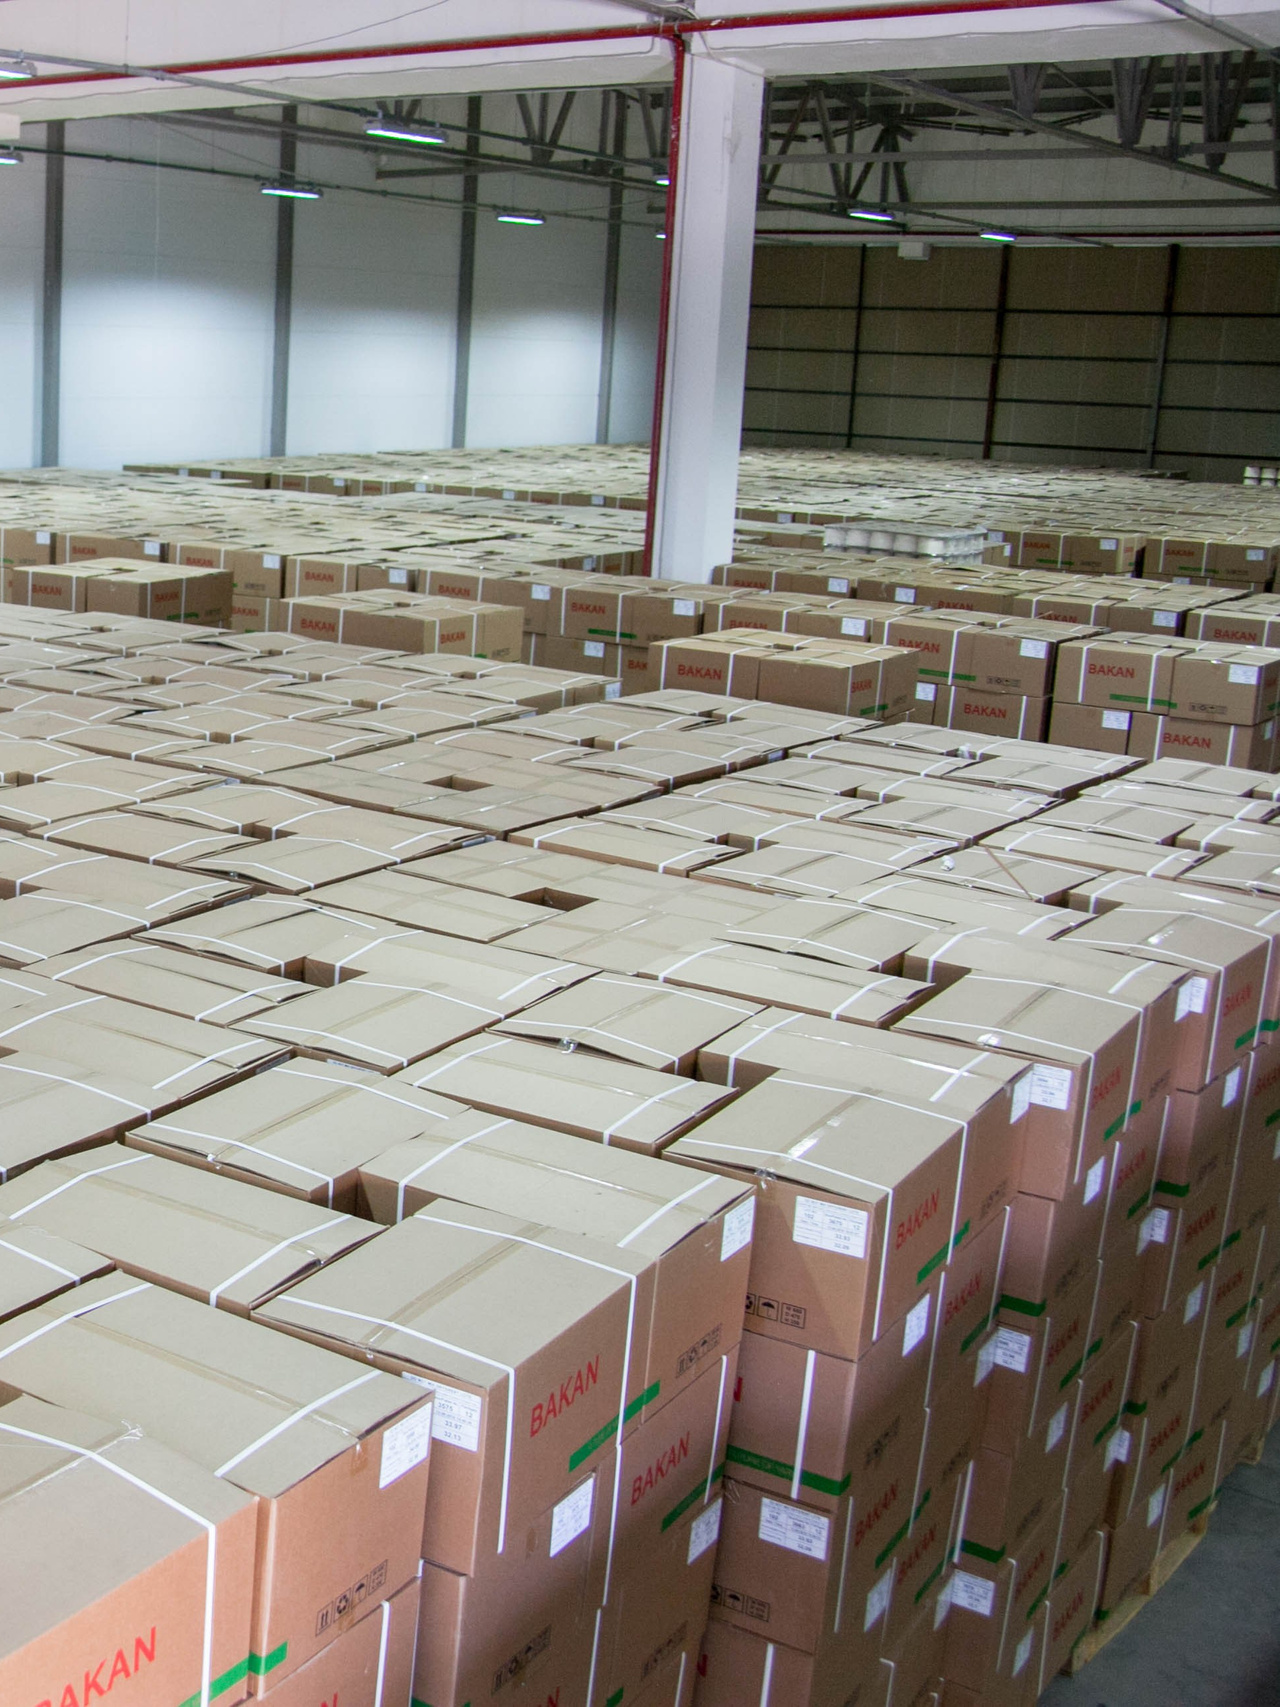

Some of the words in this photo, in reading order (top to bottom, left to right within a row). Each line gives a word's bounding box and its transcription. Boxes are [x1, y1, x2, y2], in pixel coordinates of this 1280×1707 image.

[186, 557, 213, 567] BAKAN
[305, 572, 333, 582] BAKAN
[32, 584, 61, 595] BAKAN
[439, 585, 470, 597] BAKAN
[154, 591, 179, 603] BAKAN
[231, 607, 258, 616] BAKAN
[571, 603, 605, 614] BAKAN
[937, 601, 972, 610] BAKAN
[301, 619, 335, 632] BAKAN
[440, 632, 466, 644] BAKAN
[1214, 629, 1256, 642] BAKAN
[628, 660, 647, 669] BAK
[678, 664, 722, 679] BAKAN
[1088, 664, 1135, 679] BAKAN
[851, 680, 872, 694] BAKAN
[964, 704, 1006, 717] BAKAN
[1163, 733, 1211, 750] BAKAN
[896, 1189, 939, 1250] BAKAN
[530, 1357, 599, 1437] BAKAN
[631, 1434, 689, 1505] BAKAN
[36, 1627, 156, 1707] AKAN
